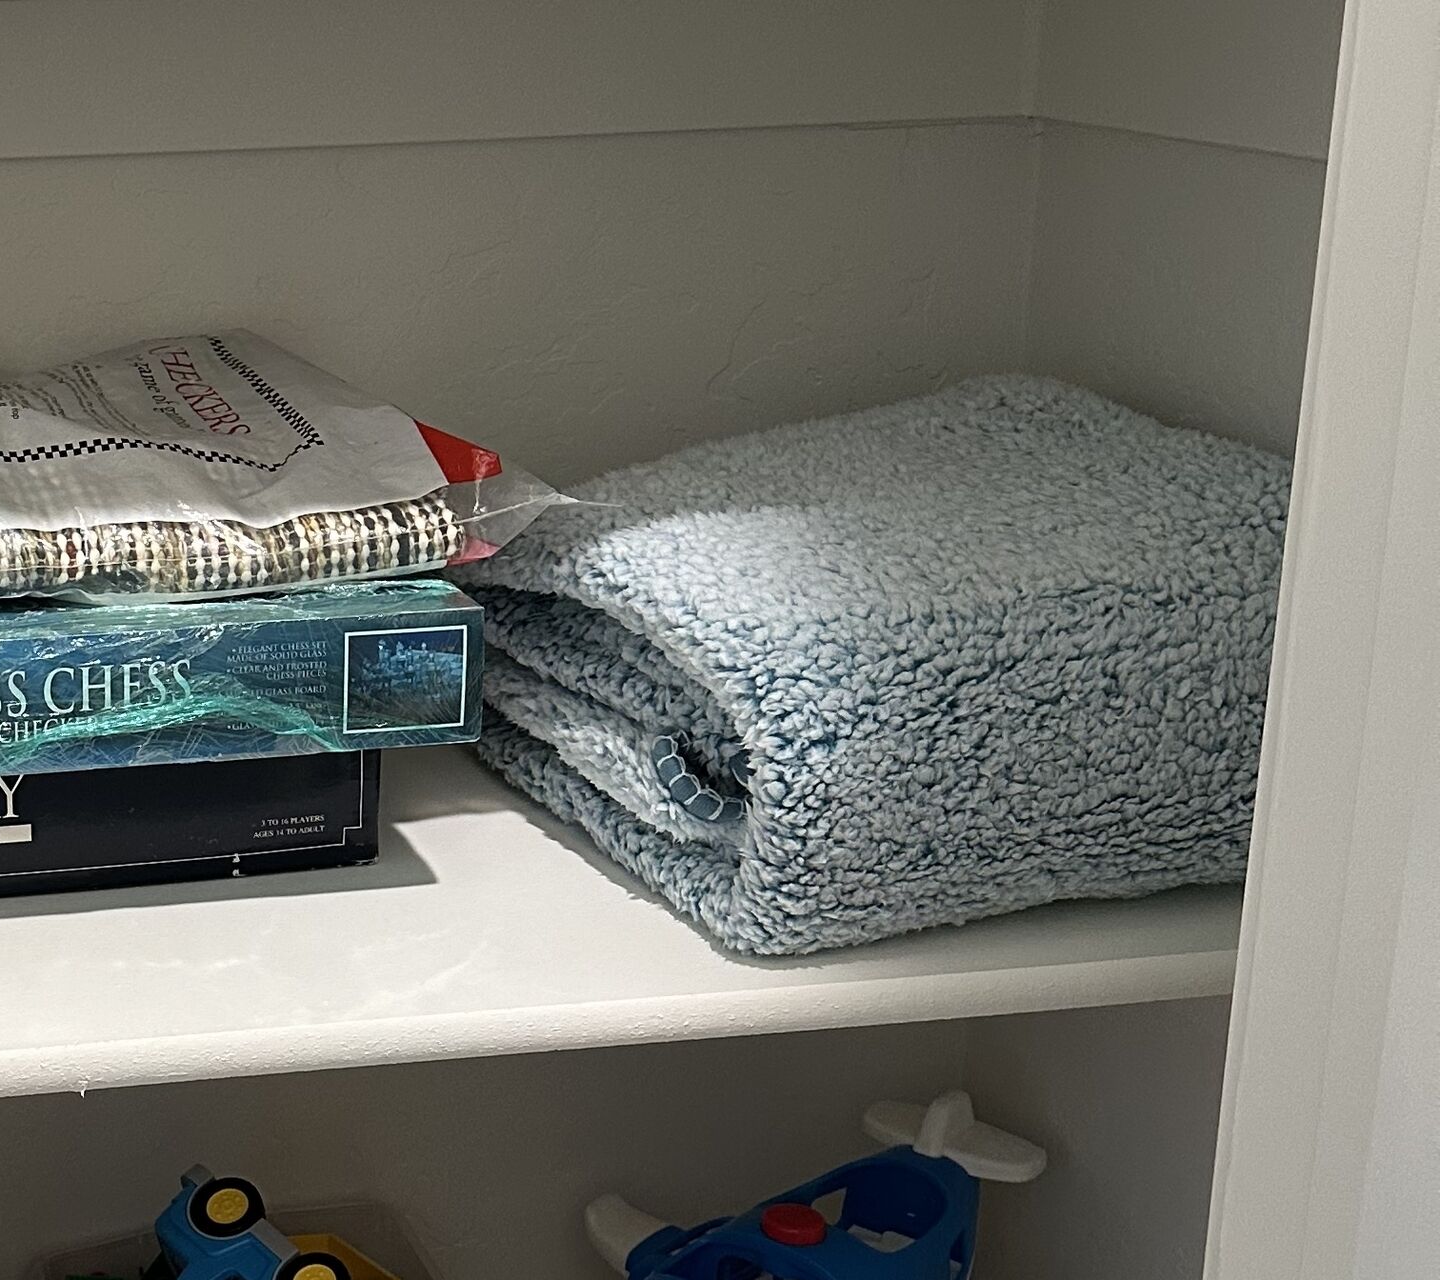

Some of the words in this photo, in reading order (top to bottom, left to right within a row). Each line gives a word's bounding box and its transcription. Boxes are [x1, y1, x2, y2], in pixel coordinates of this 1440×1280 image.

[280, 642, 311, 651] CHESS
[270, 651, 298, 660] SOLID
[300, 650, 327, 658] GLASS
[262, 663, 284, 672] AND
[286, 661, 327, 670] FROSTED
[43, 659, 192, 714] CHESS
[294, 685, 326, 694] BOARD
[290, 814, 325, 824] PLAYERS
[253, 830, 274, 839] AGES
[286, 827, 297, 835] TO
[299, 825, 325, 833] ADULT
